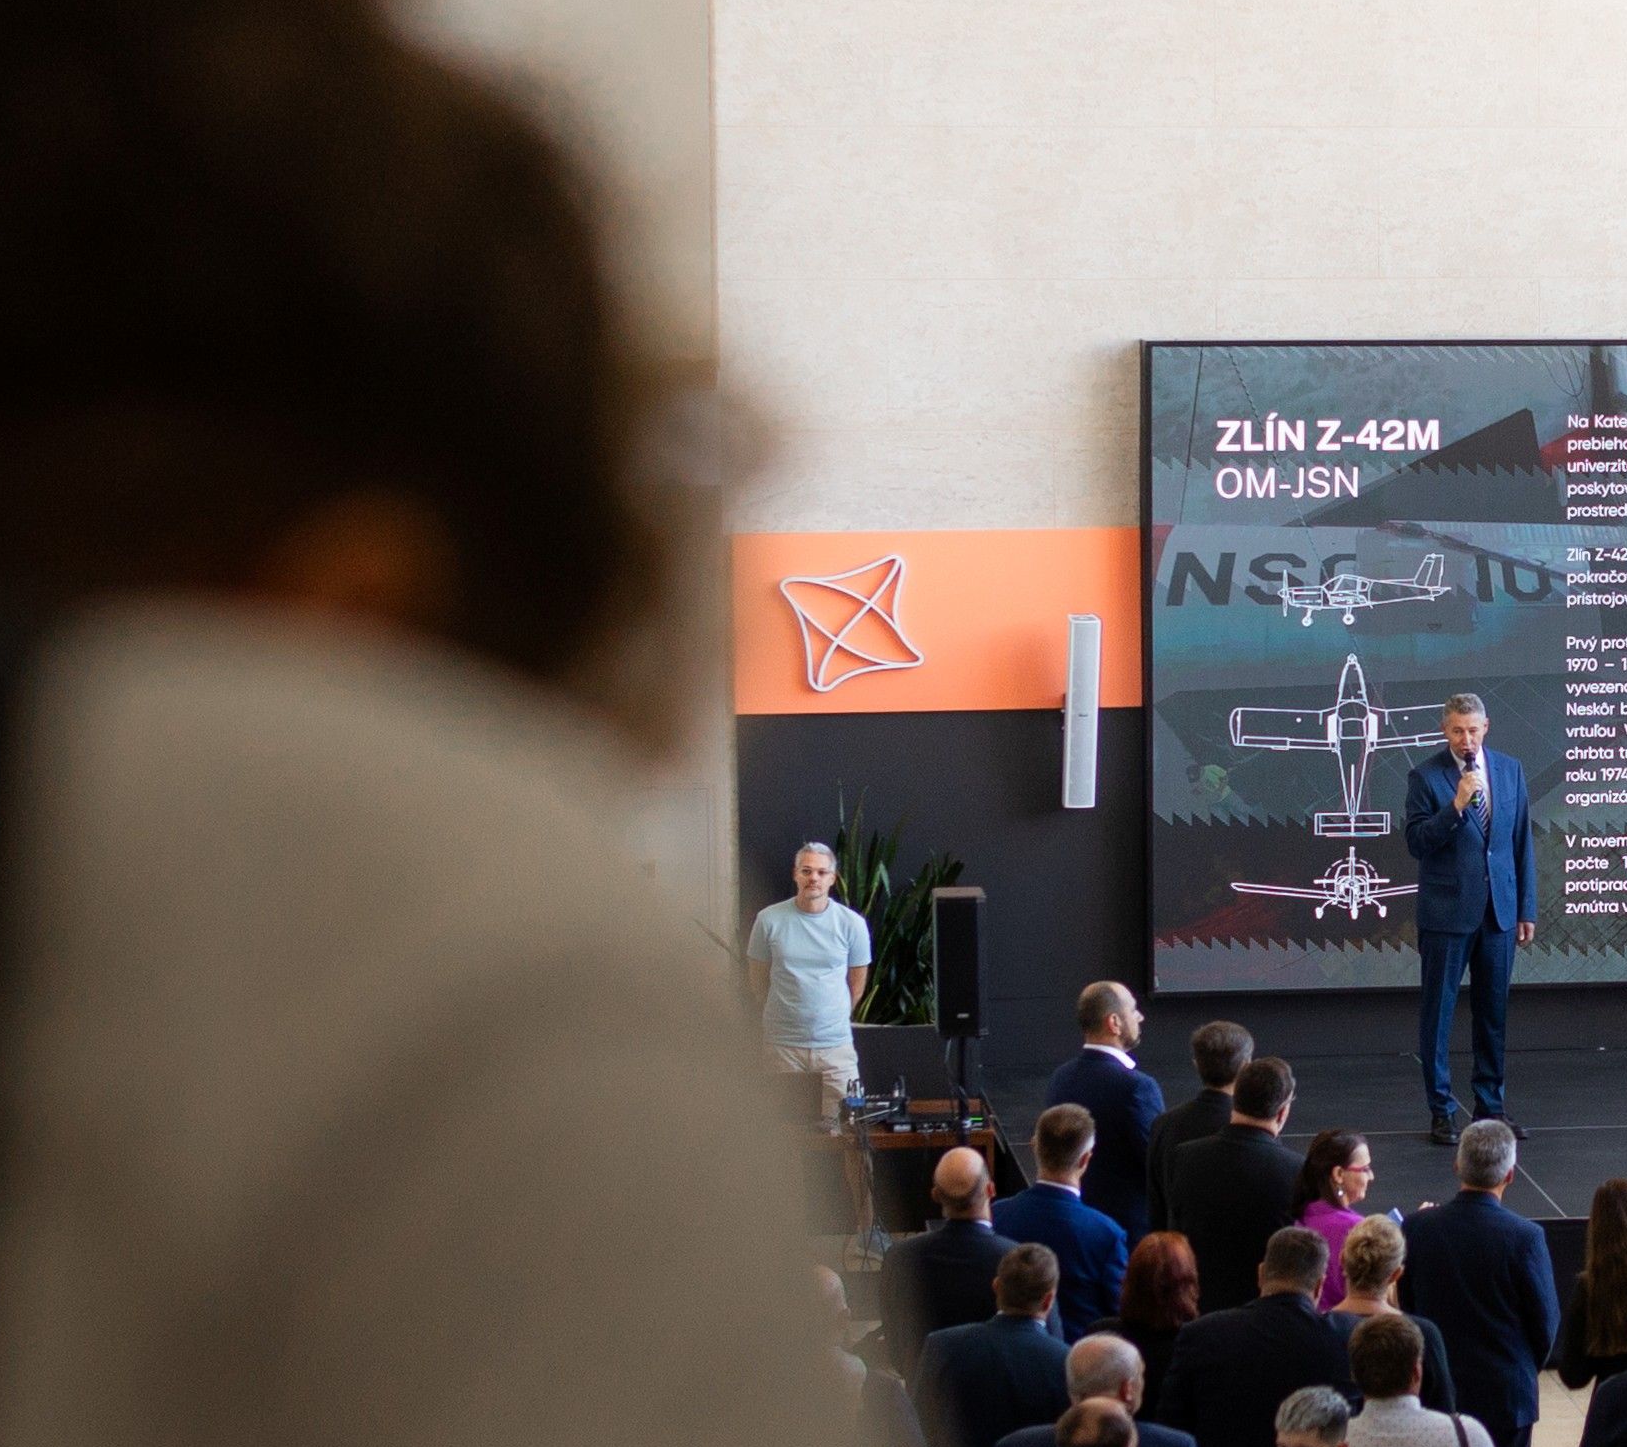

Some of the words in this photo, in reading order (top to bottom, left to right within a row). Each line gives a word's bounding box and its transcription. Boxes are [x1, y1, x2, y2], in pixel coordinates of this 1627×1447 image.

[1216, 413, 1304, 451] ZLÍN
[1316, 419, 1439, 451] Z-42M
[1216, 467, 1358, 498] OM-JSN
[1566, 702, 1615, 715] Neskôr
[1565, 724, 1615, 737] vrtuľou
[1565, 745, 1614, 759] chrbta
[1565, 856, 1608, 872] počte
[1565, 899, 1619, 913] zvnútra
